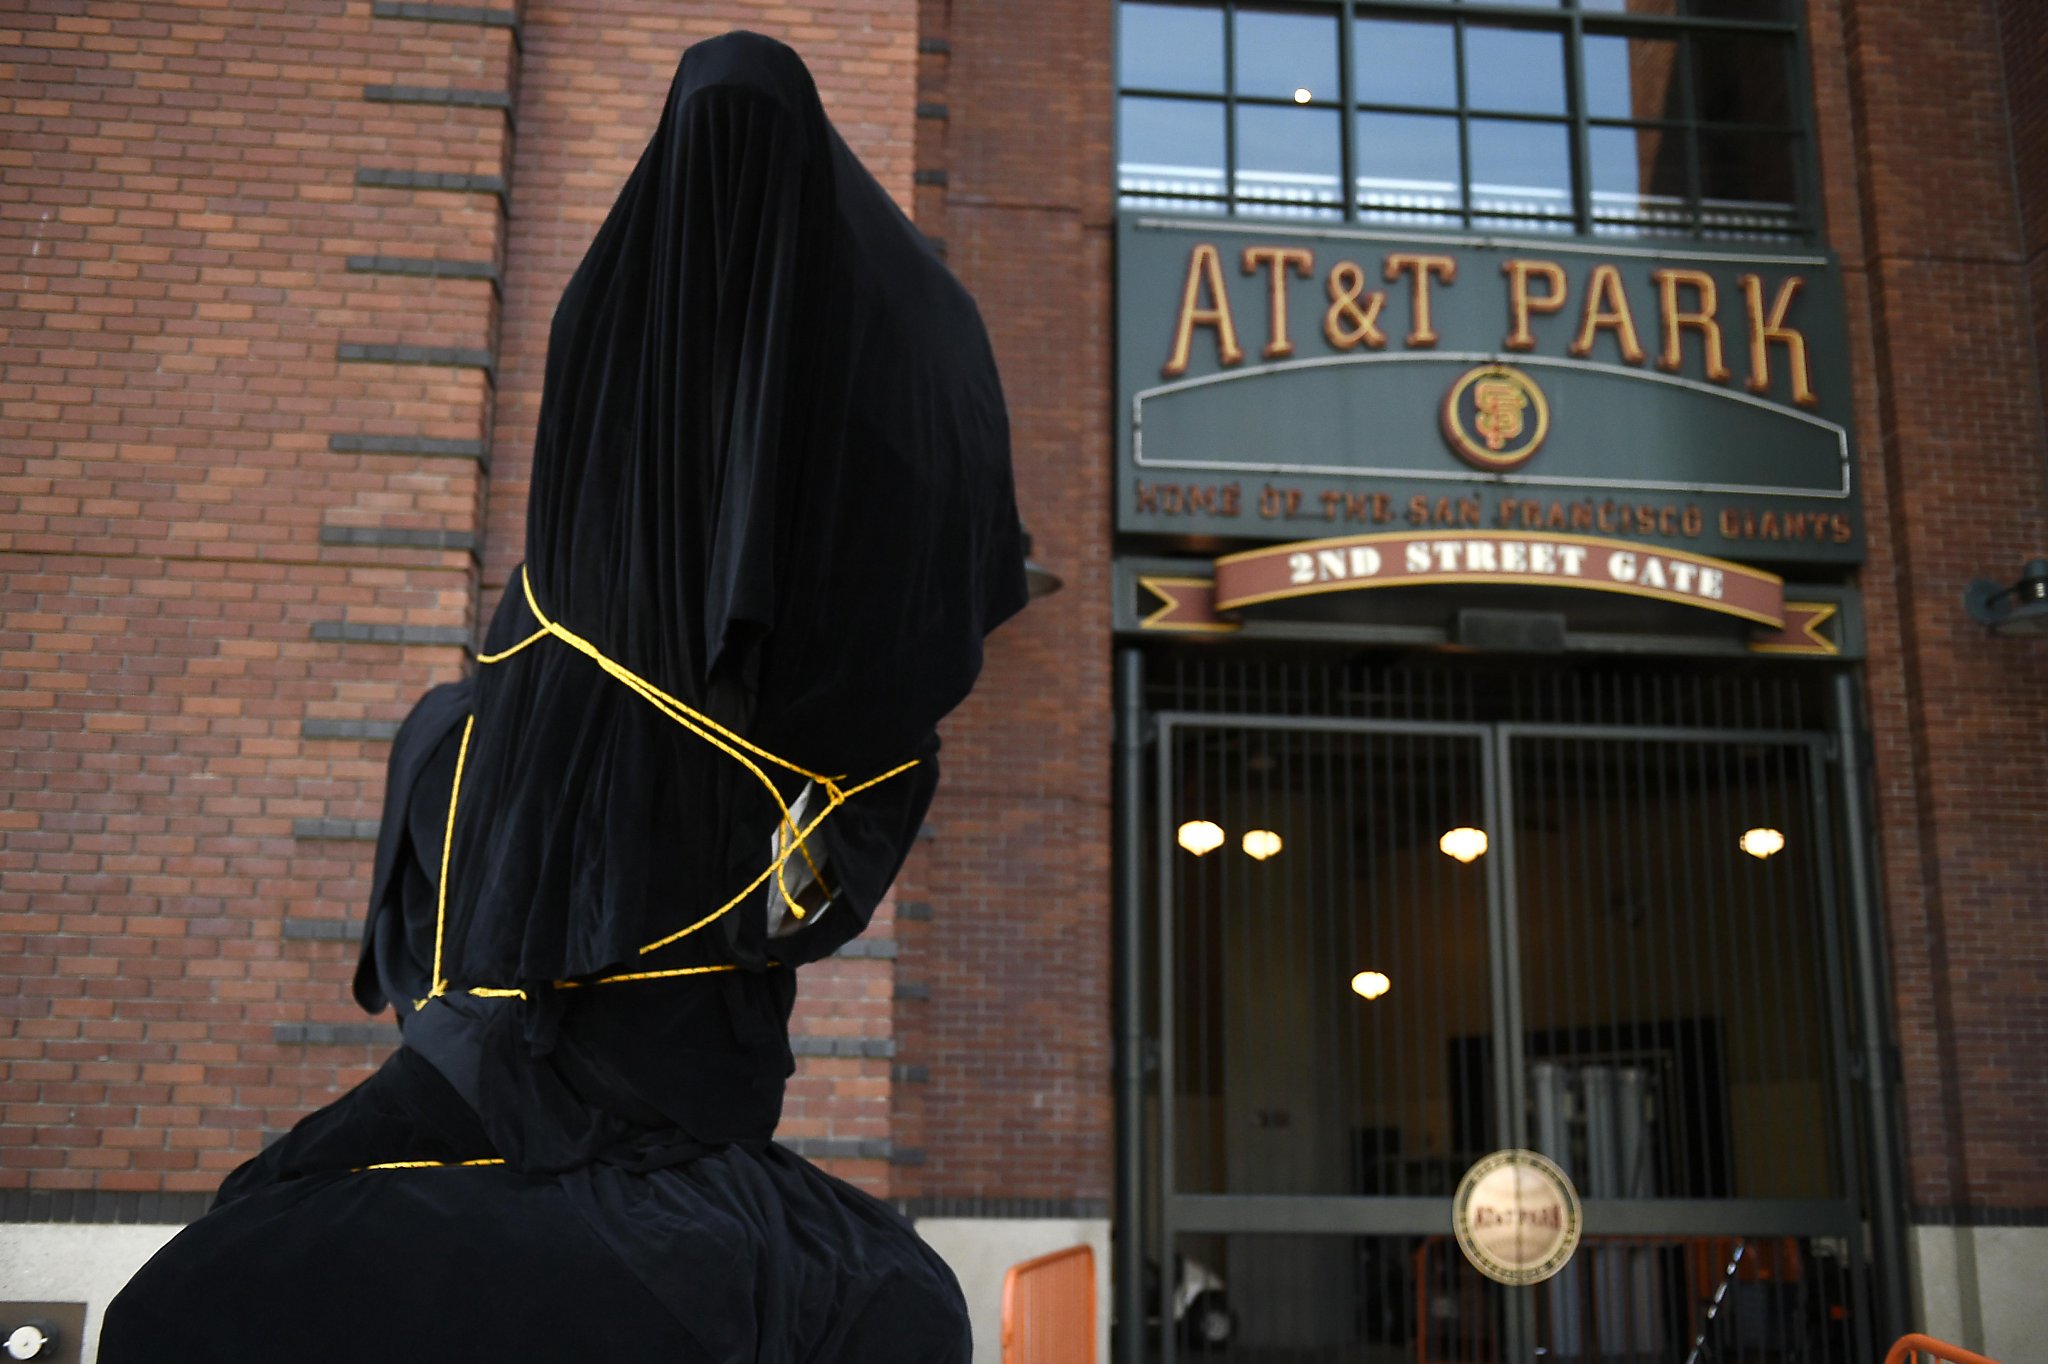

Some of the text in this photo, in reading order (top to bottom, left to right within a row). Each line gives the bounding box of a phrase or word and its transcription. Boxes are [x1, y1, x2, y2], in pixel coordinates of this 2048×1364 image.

[1161, 243, 1818, 406] AT&T PARK
[1134, 480, 1852, 543] HOME OF THE SAN FRANCISCO GIANTS
[1288, 540, 1725, 600] 2ND STREET GATE
